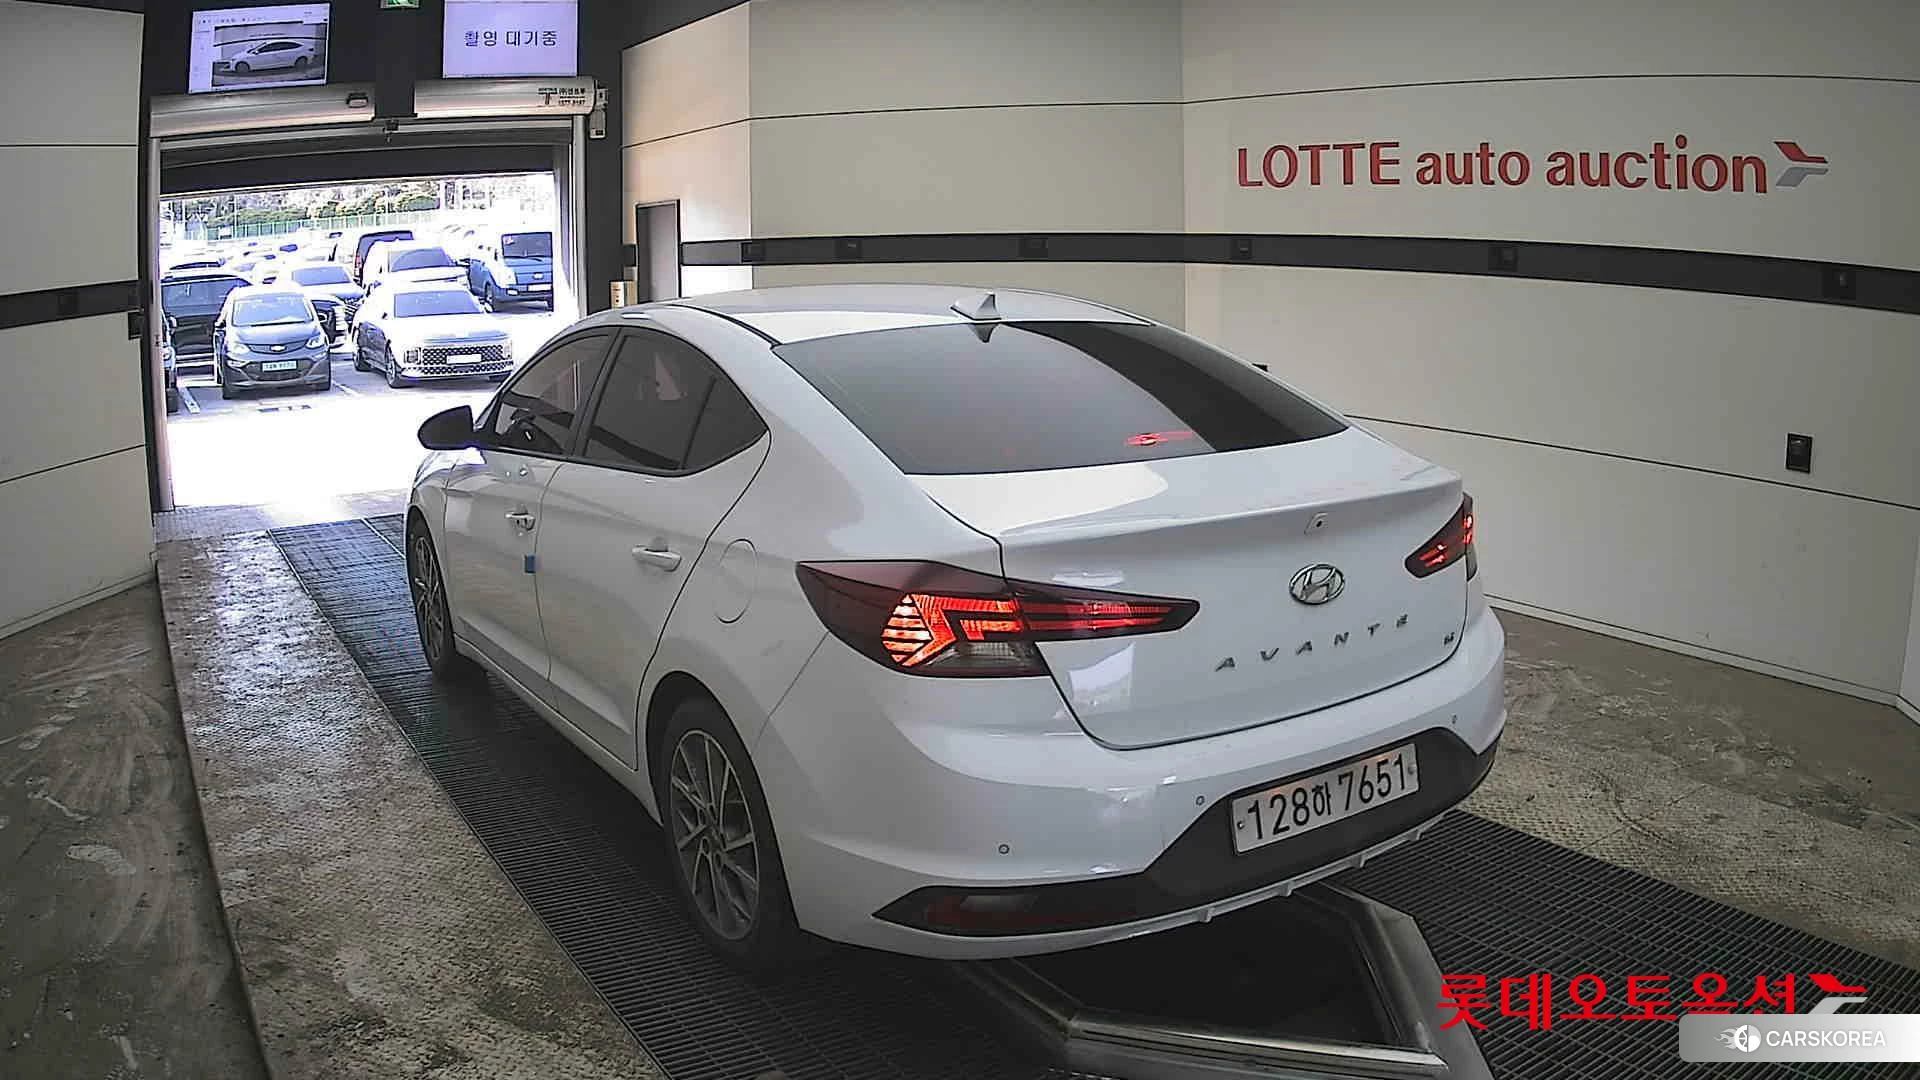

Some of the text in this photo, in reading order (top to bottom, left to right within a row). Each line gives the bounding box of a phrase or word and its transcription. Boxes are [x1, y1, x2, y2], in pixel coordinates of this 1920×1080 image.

[506, 30, 558, 47] 대기중
[1238, 135, 1767, 193] LOTTE auto auction
[1215, 613, 1409, 671] AVANTE
[1247, 753, 1406, 840] 128하 7651
